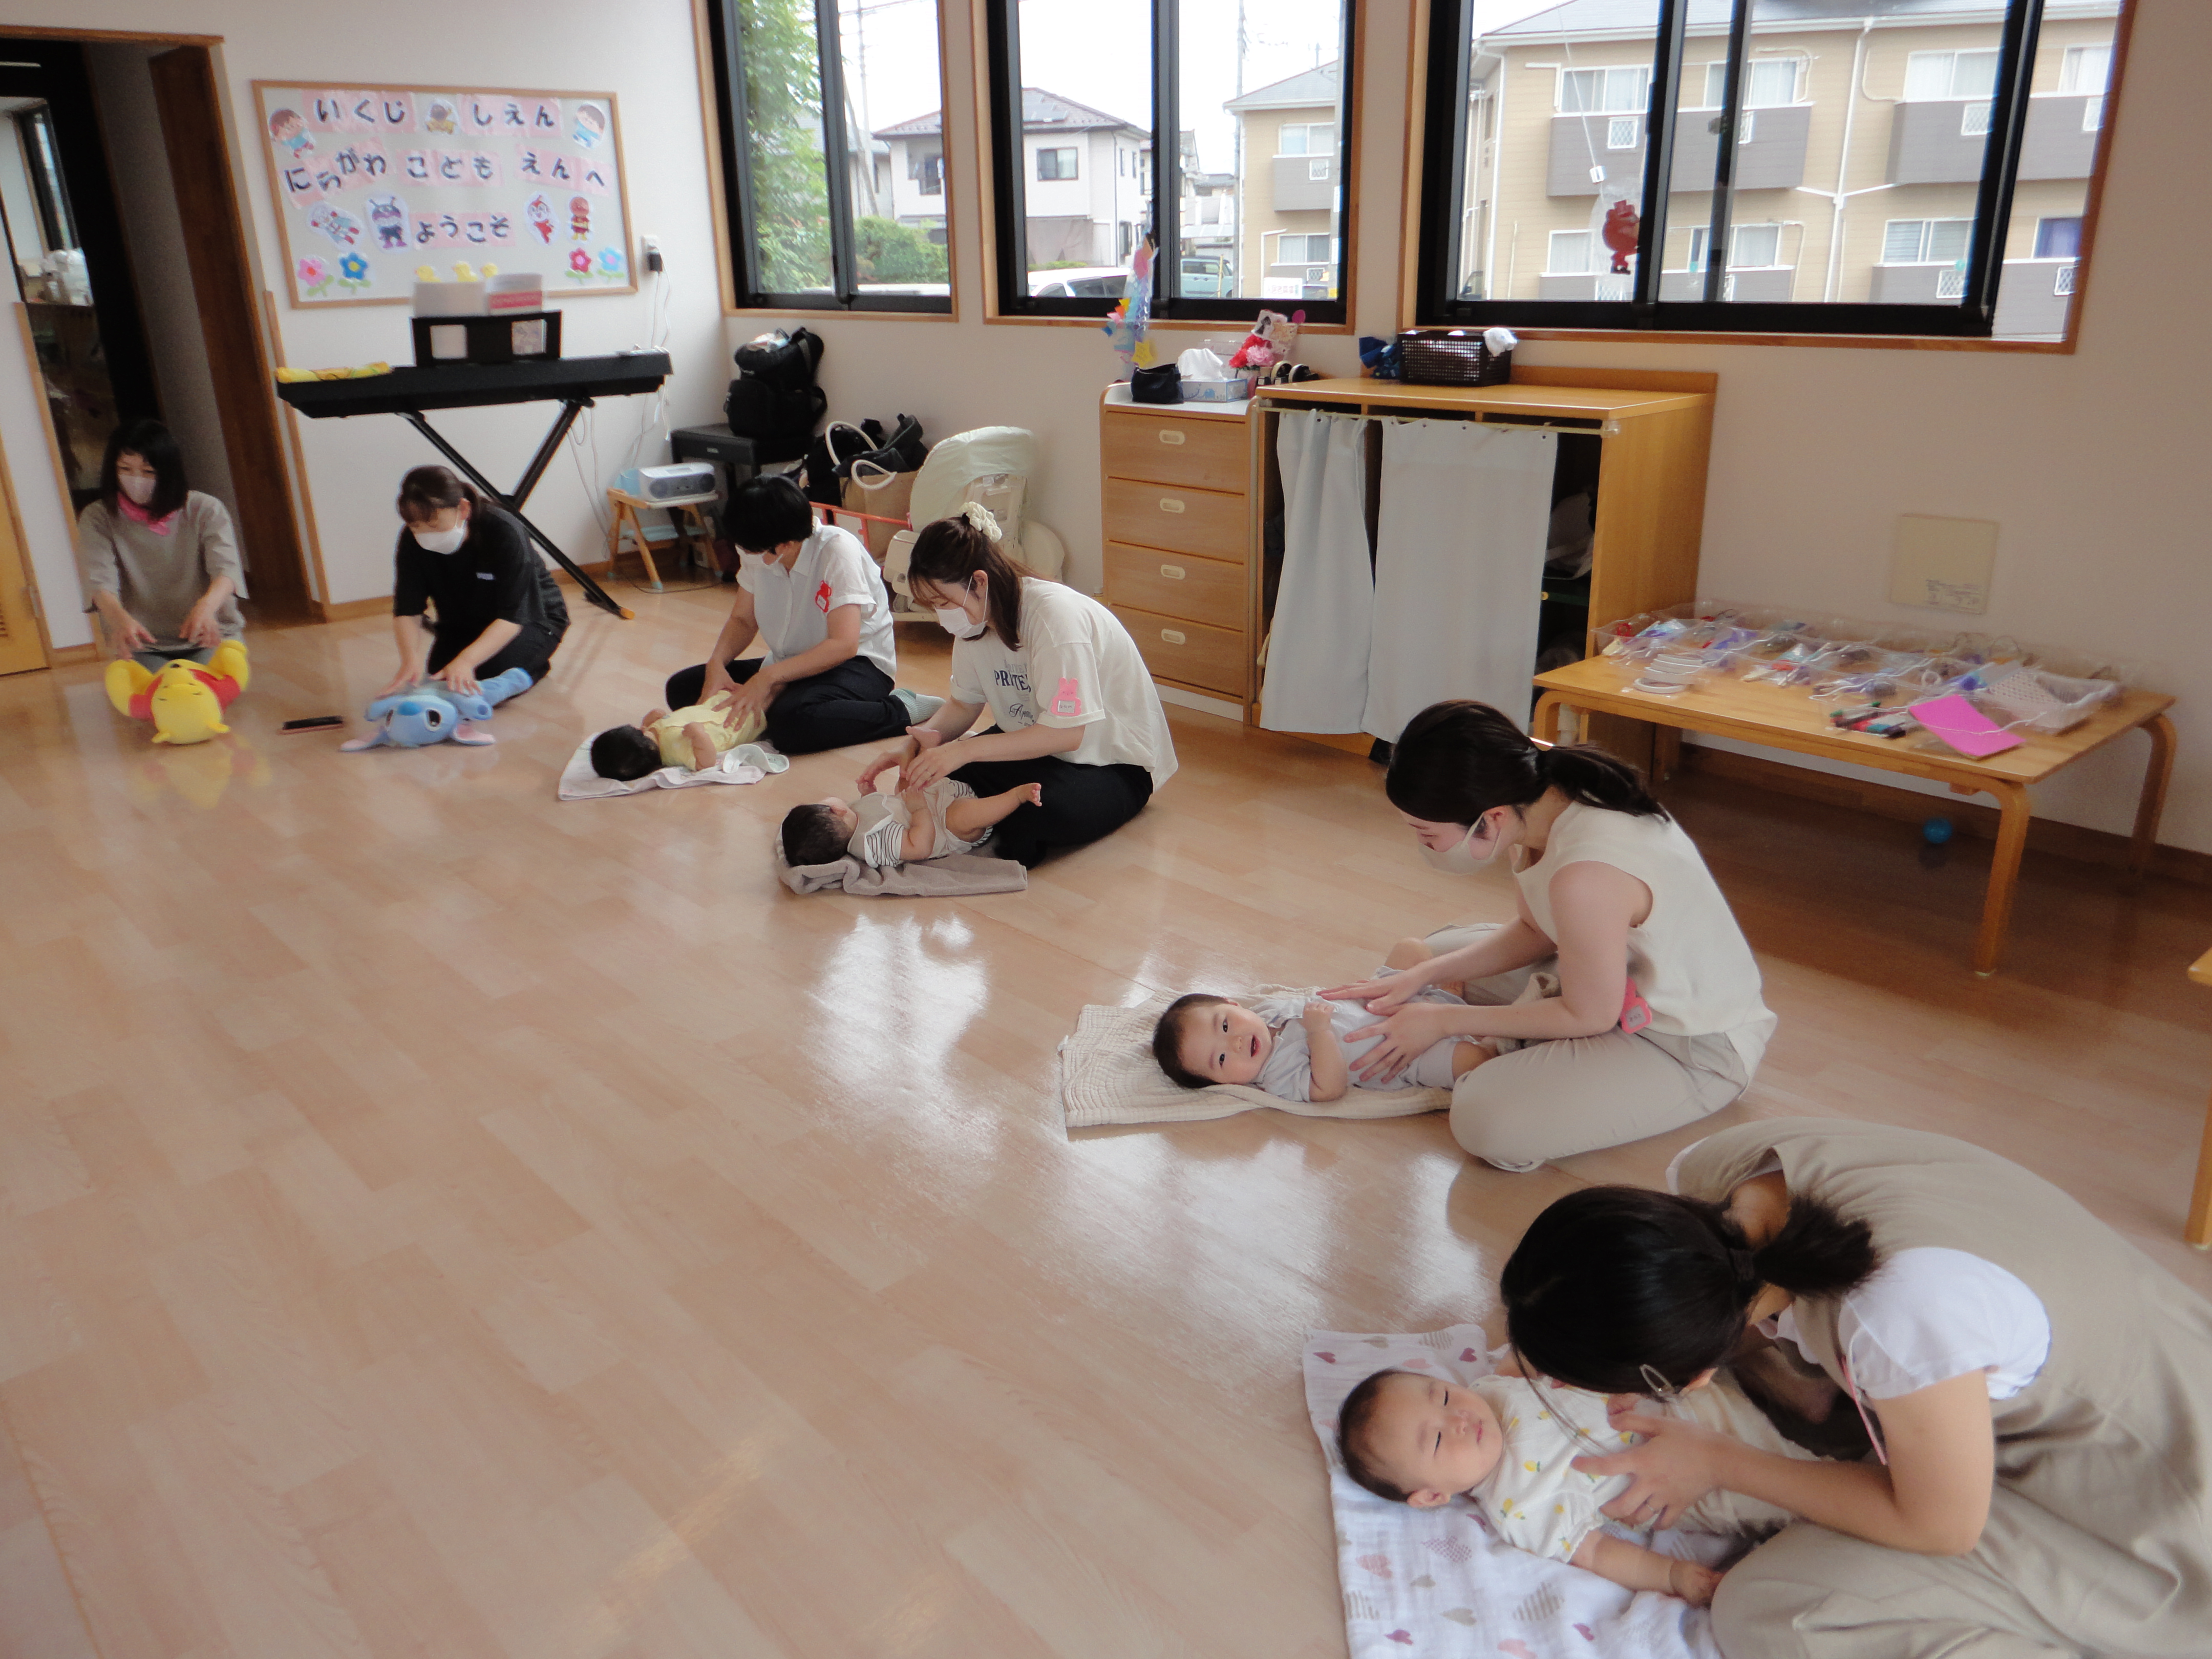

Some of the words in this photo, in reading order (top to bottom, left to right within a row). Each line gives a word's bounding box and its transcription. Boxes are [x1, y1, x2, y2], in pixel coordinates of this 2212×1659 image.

[315, 99, 406, 123] いくじ
[472, 103, 555, 127] しえん
[406, 155, 494, 179] こども
[521, 152, 605, 186] えんへ
[416, 214, 509, 244] ようこそ
